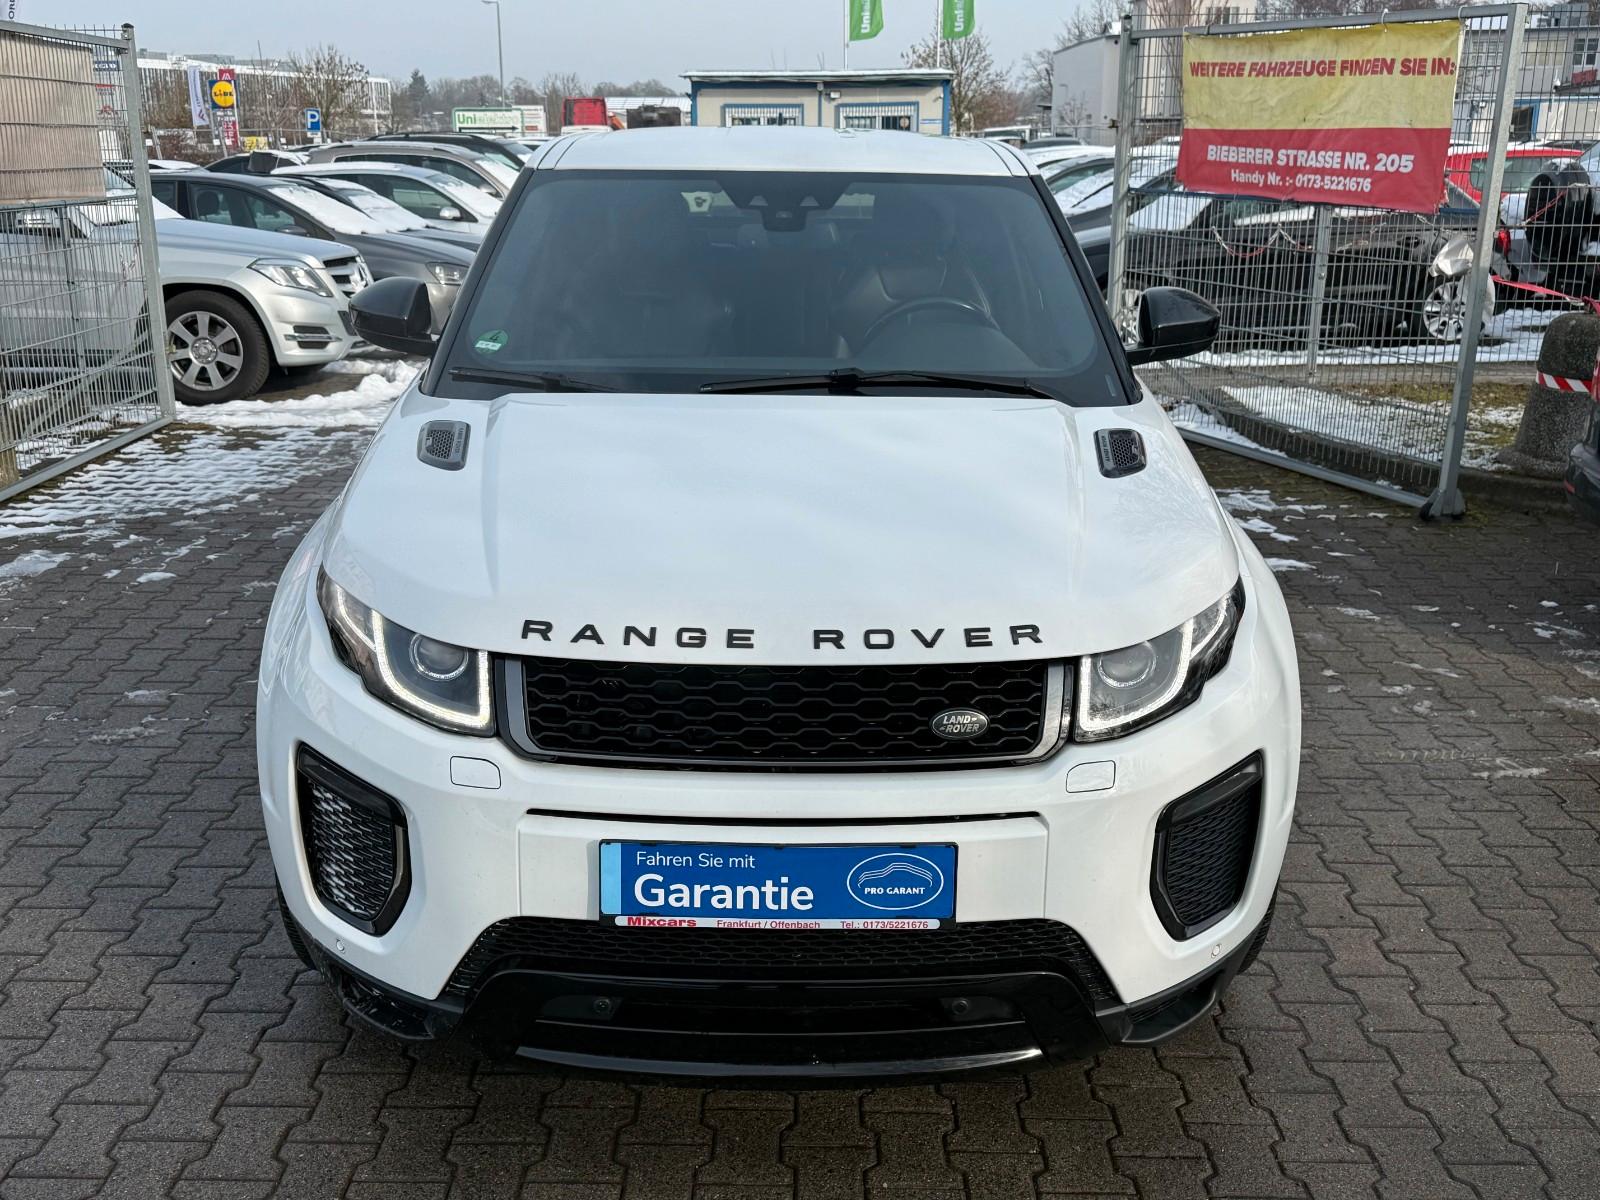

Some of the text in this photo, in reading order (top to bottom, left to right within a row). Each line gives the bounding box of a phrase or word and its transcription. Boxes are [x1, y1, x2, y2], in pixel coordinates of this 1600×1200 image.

[1189, 57, 1457, 78] WEITERE FAHRZEUGE FINDEN SIE IN:
[213, 89, 234, 97] LIDL
[307, 110, 319, 129] P
[1207, 144, 1416, 174] BIEBERER STRASSE NR. 205
[1230, 168, 1265, 188] Handy
[1267, 171, 1283, 187] Nr.
[1294, 173, 1372, 193] 0173-5221676
[521, 619, 1042, 650] RANGE ROVER
[636, 851, 756, 869] Fahren Sie mit
[634, 872, 815, 911] Garantie
[864, 886, 925, 895] PRO GARANT
[627, 916, 697, 927] Mixcars
[717, 919, 761, 929] Frankfurt
[770, 920, 821, 930] Offenbach
[840, 920, 860, 930] Tel.:
[863, 920, 929, 930] 0173/5221676
